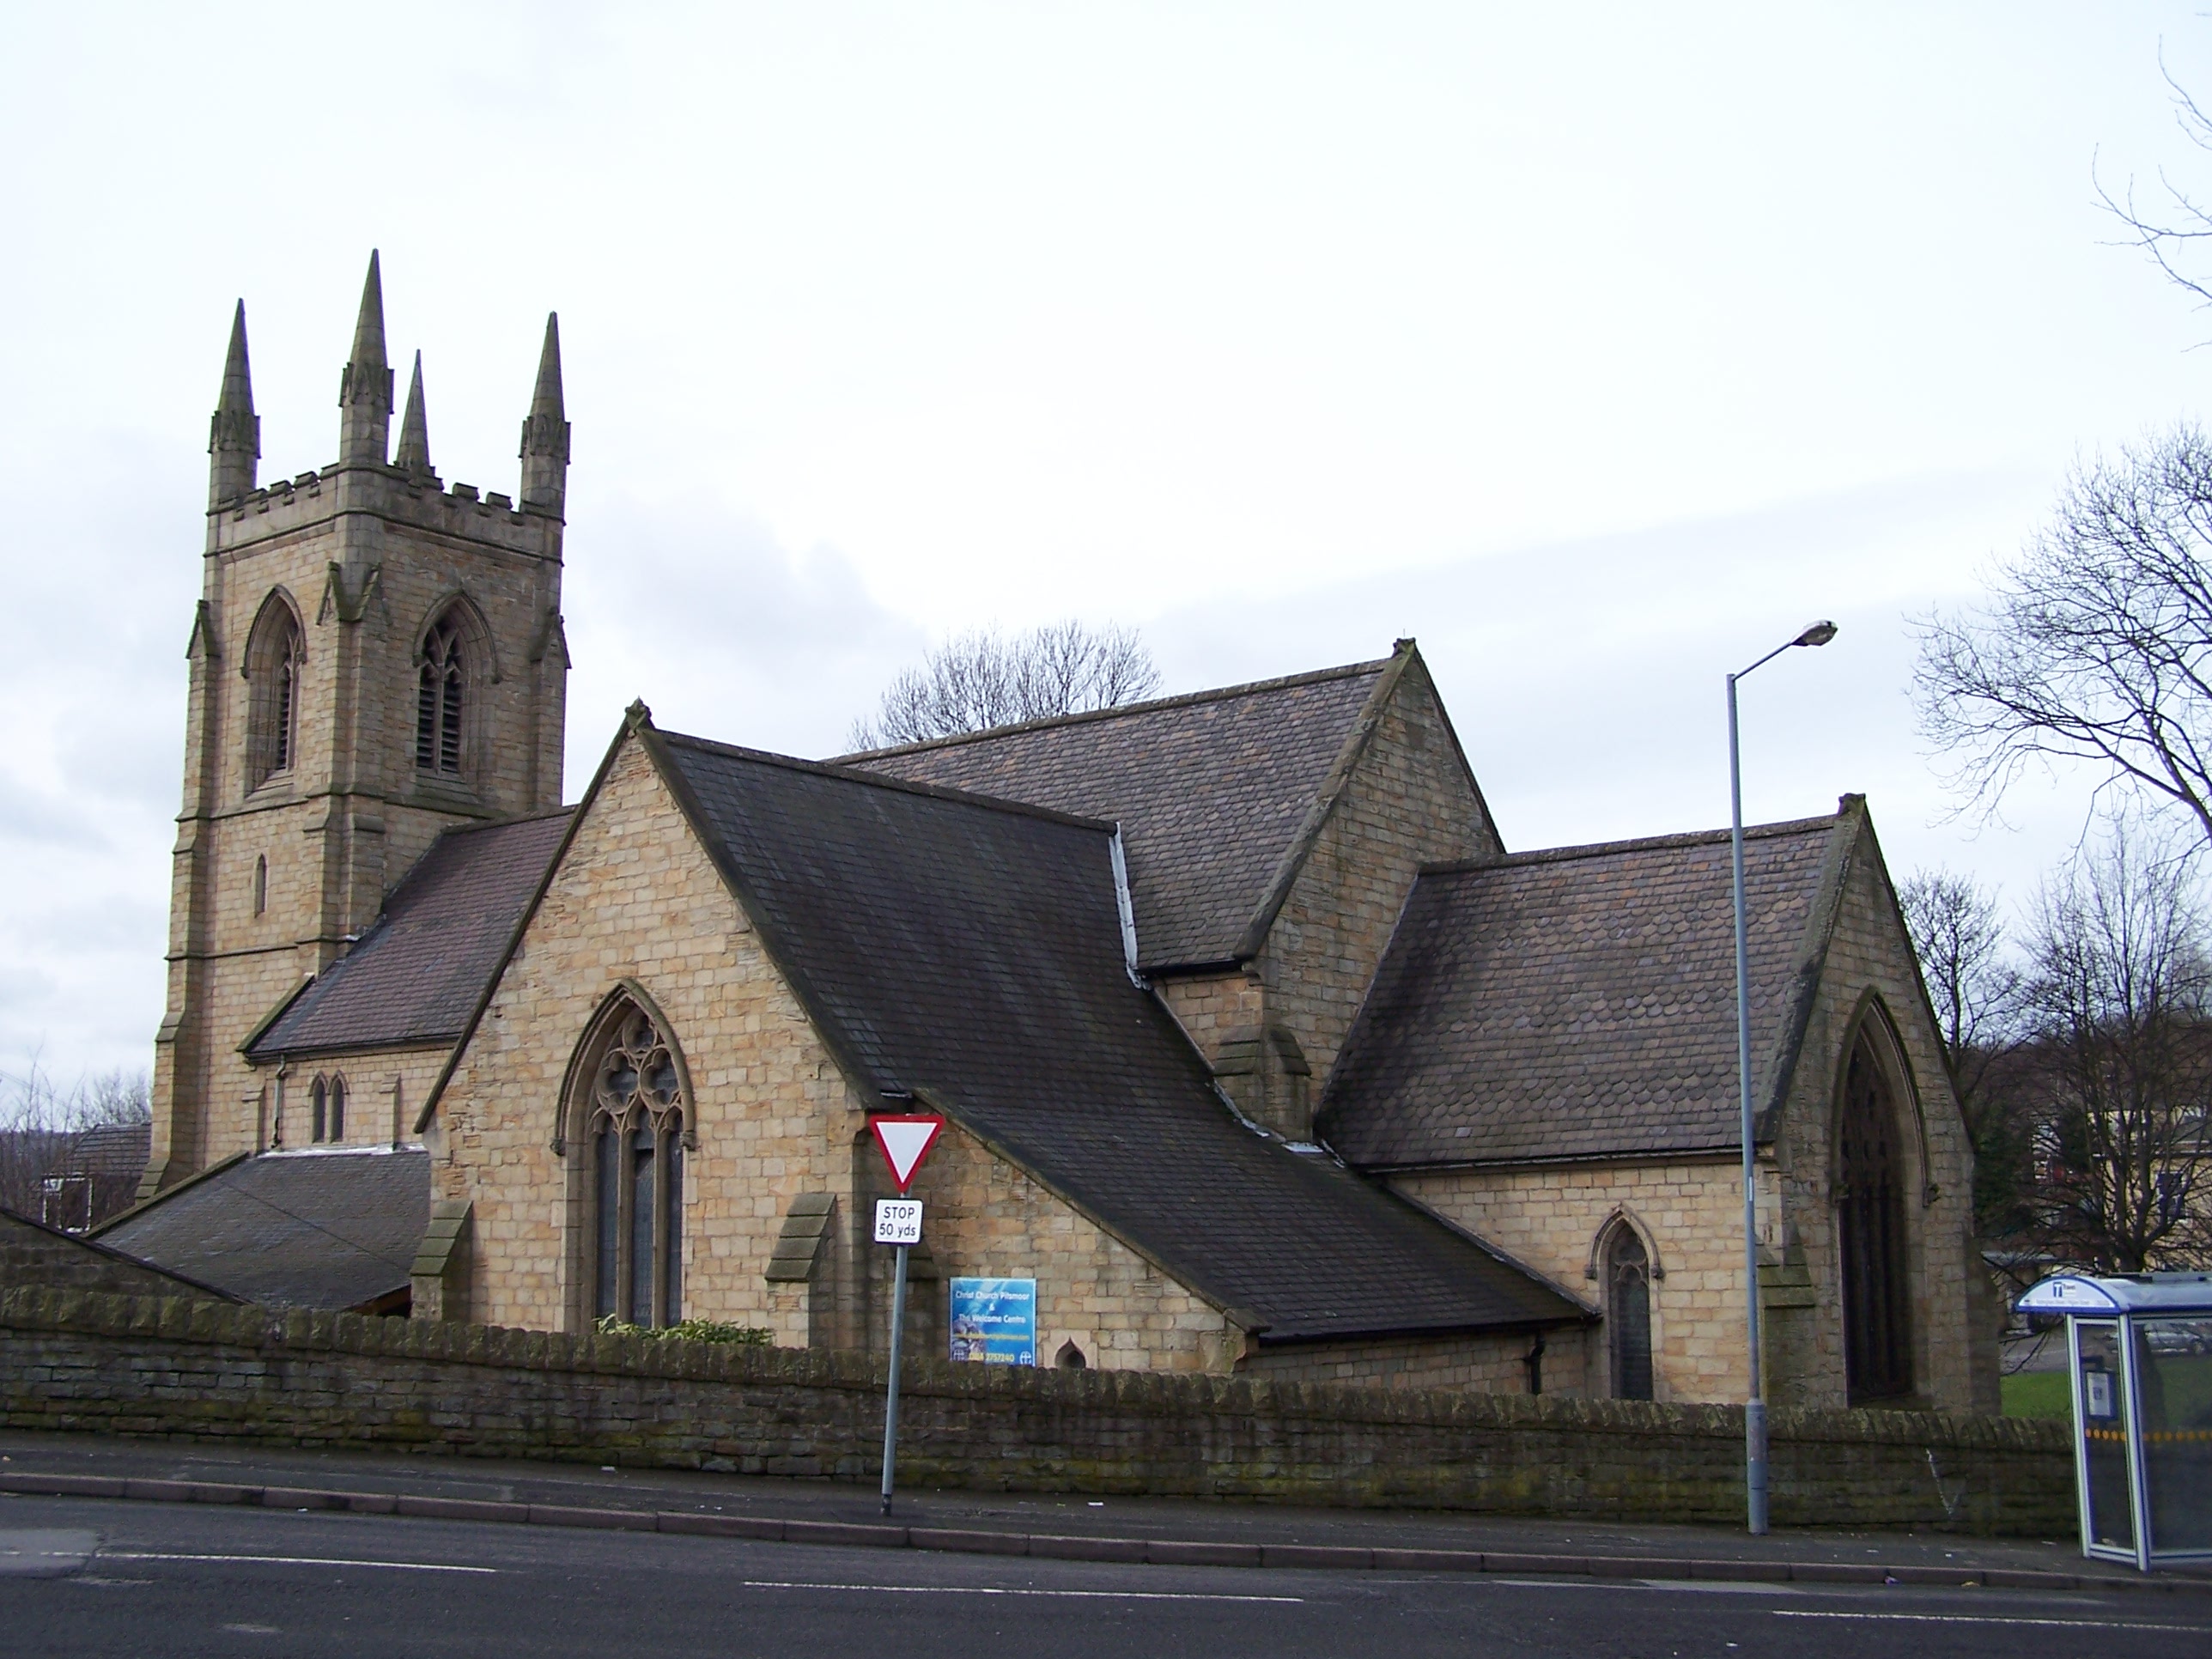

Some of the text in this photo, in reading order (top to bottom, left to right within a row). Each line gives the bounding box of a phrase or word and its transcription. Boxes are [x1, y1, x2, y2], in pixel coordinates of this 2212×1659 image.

[884, 1206, 915, 1218] STOP
[879, 1223, 915, 1237] 50 yds
[956, 1291, 974, 1299] Christ
[1000, 1291, 1030, 1300] Pitsmoor
[972, 1315, 1002, 1323] Welcome
[1004, 1315, 1026, 1323] Centre
